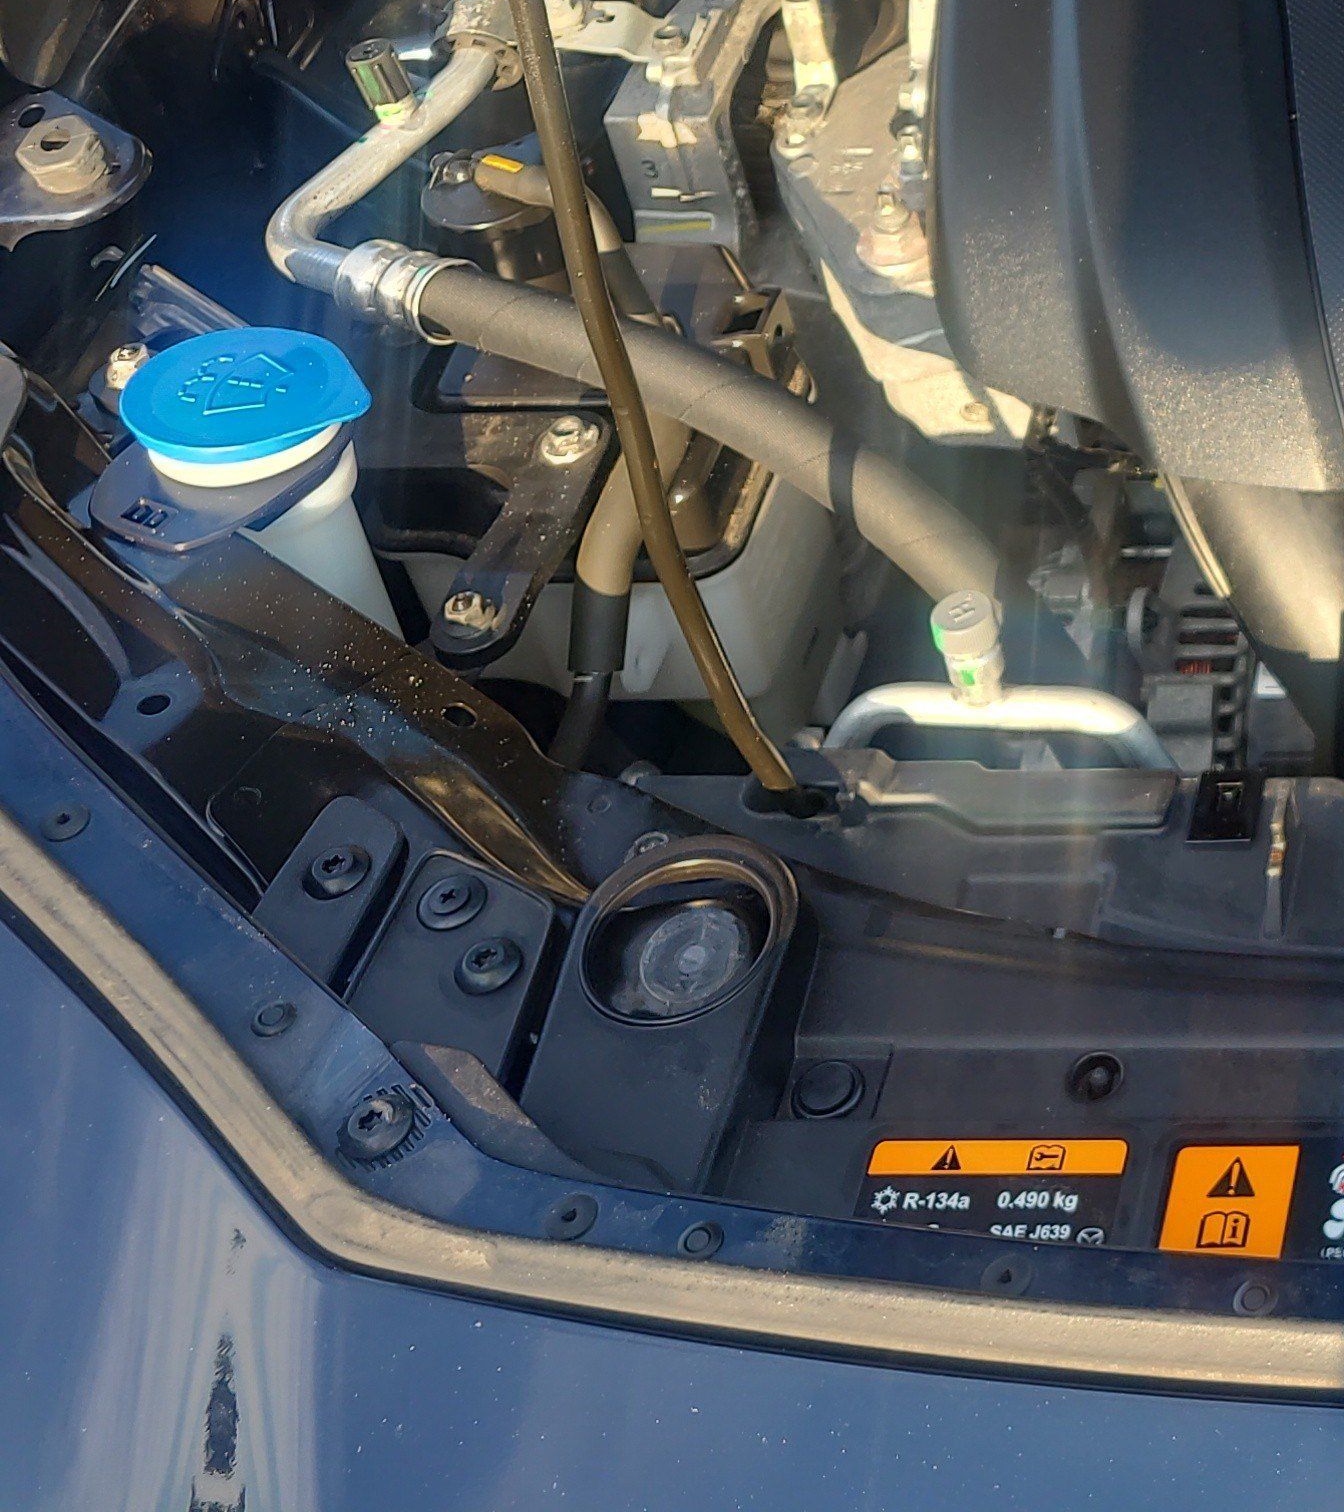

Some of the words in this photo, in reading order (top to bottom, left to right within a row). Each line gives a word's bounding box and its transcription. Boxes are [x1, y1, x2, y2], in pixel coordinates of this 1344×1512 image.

[902, 1192, 971, 1211] R-134a
[997, 1191, 1051, 1210] 0.490
[1052, 1191, 1079, 1213] kg
[989, 1224, 1028, 1239] SAE
[1028, 1224, 1072, 1241] J639
